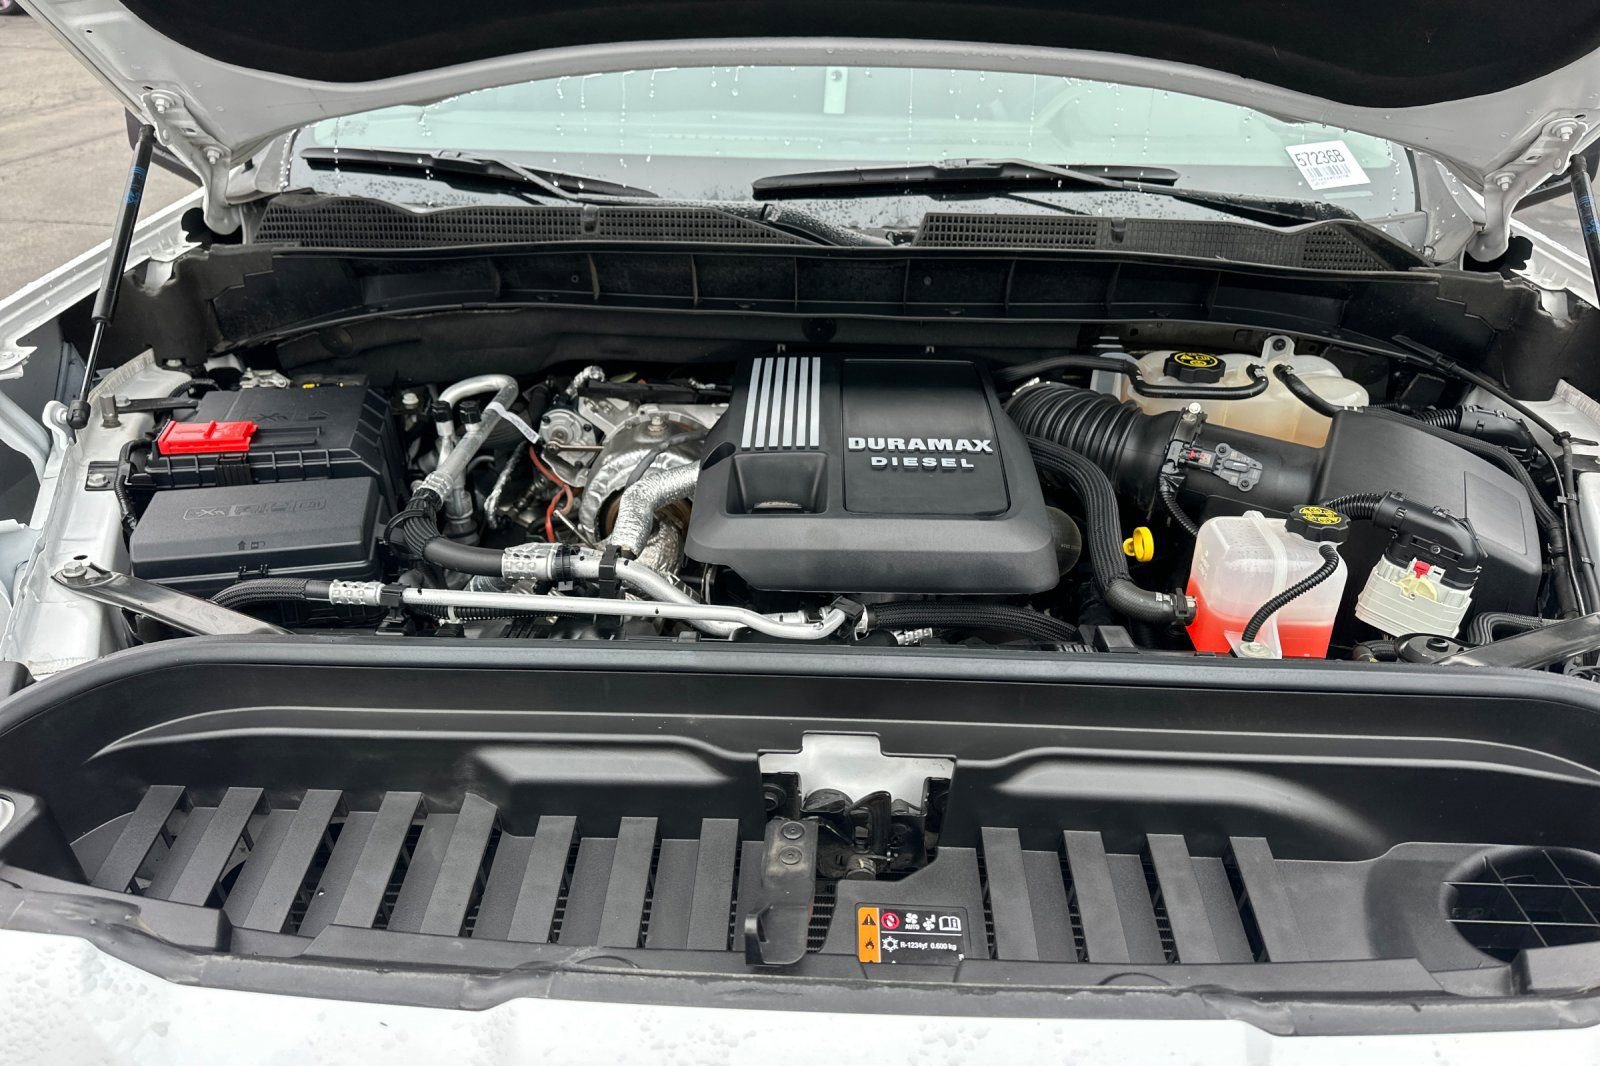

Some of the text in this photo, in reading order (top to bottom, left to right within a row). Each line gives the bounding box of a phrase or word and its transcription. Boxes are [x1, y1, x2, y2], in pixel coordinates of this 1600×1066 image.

[1294, 149, 1346, 167] 57236B
[848, 437, 993, 453] DURAMAX
[871, 456, 974, 469] DIESEL
[948, 943, 957, 951] kg
